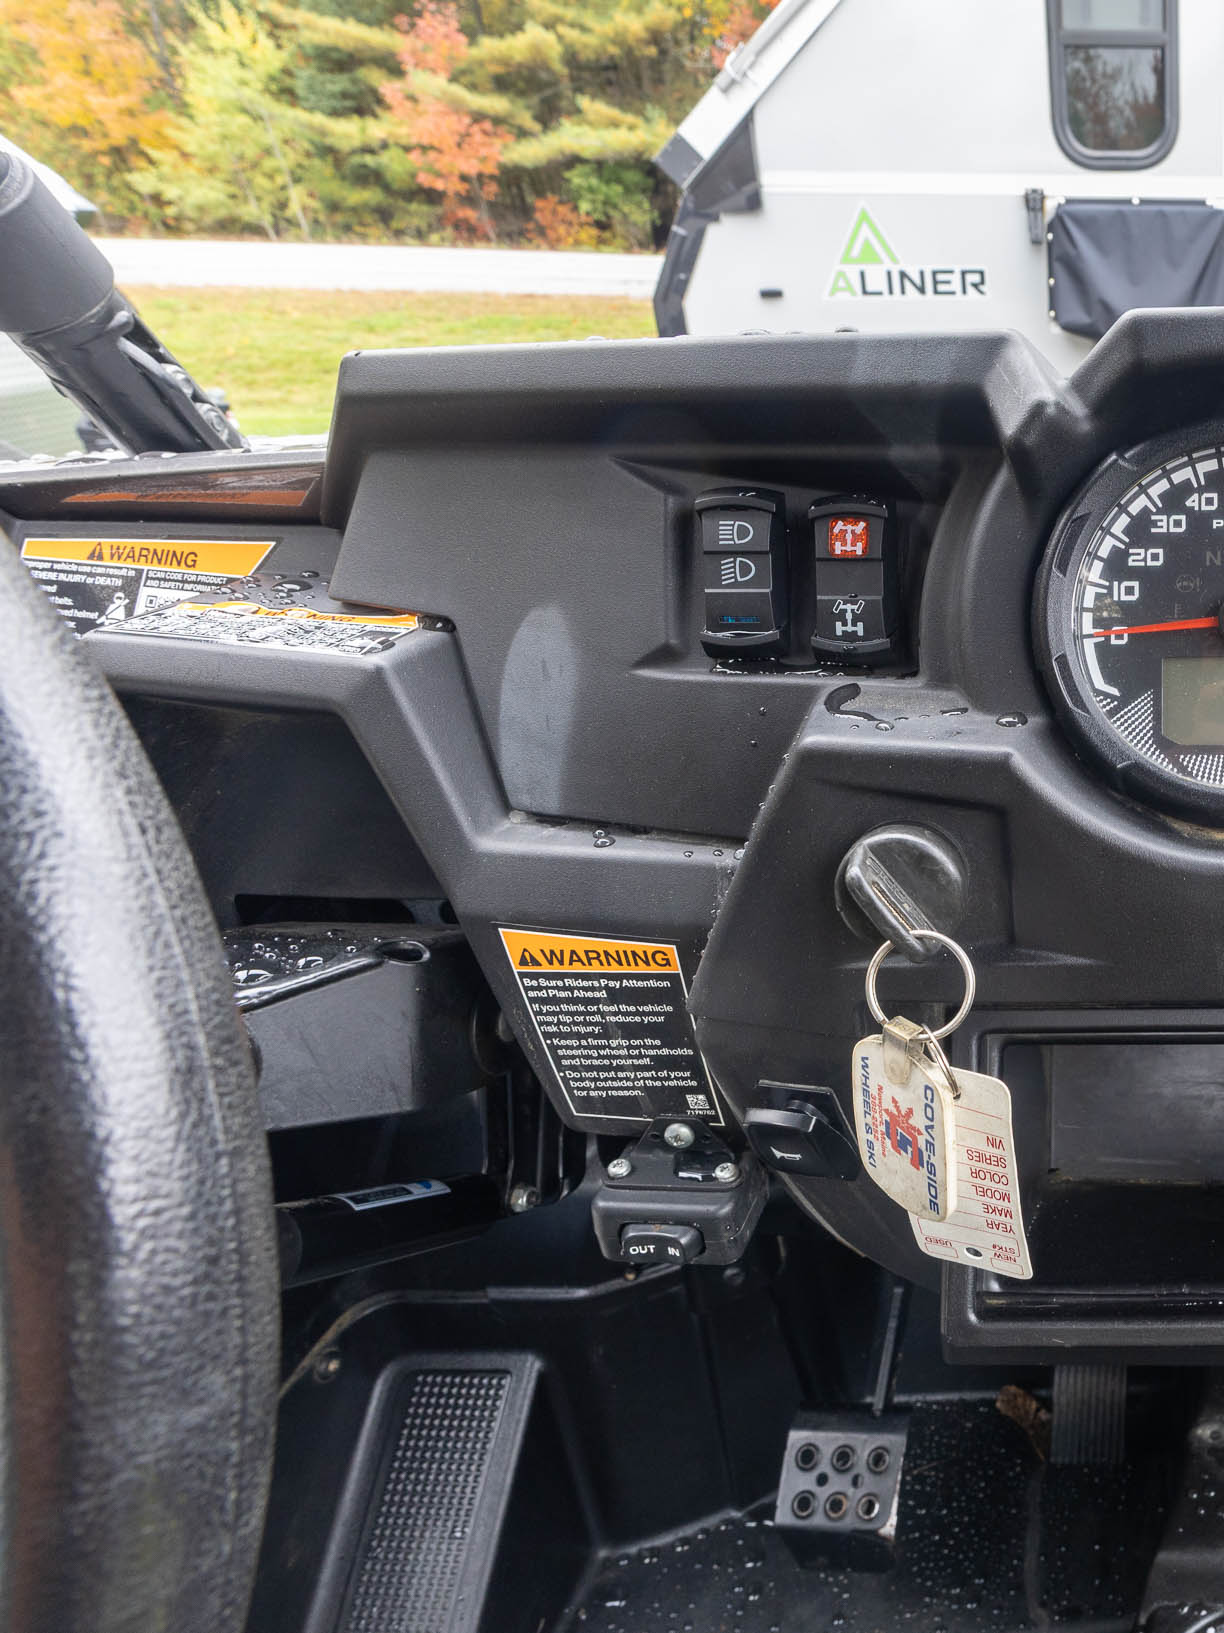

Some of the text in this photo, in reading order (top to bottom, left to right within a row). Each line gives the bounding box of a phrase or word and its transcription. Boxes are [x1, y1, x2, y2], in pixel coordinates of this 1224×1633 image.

[829, 270, 987, 296] ALINER
[1185, 492, 1218, 511] 40
[1150, 515, 1186, 533] 30
[109, 545, 199, 568] WARNING
[1128, 549, 1164, 566] 20
[1205, 550, 1222, 566] N
[95, 577, 122, 587] DEATH
[147, 570, 228, 586] SCAN CODE FOR PRODUCT
[160, 580, 184, 591] SAFETY
[1112, 581, 1140, 601] 10
[1111, 626, 1129, 645] 0
[540, 949, 672, 967] WARNING
[523, 978, 671, 989] Be Sure Riders Pay Attention
[527, 989, 607, 998] and Plan Ahead
[532, 1003, 541, 1012] If
[541, 1005, 559, 1014] you
[559, 1003, 586, 1012] think
[599, 1003, 617, 1012] feel
[618, 1004, 636, 1012] the
[637, 1004, 673, 1012] vehicle
[536, 1014, 665, 1024] may tip or roll, reduce your
[541, 1024, 603, 1034] risk to injury:
[553, 1038, 579, 1047] Keep
[588, 1038, 608, 1046] firm
[609, 1038, 629, 1048] grip
[643, 1038, 661, 1046] the
[557, 1048, 598, 1057] steering
[598, 1048, 628, 1056] wheel
[641, 1048, 694, 1056] handholds
[610, 1058, 654, 1067] yourself.
[599, 1071, 616, 1080] put
[617, 1071, 635, 1080] any
[636, 1071, 657, 1080] part
[668, 1071, 691, 1080] your
[570, 1080, 595, 1089] body
[573, 1089, 587, 1097] for
[589, 1090, 607, 1098] any
[861, 1056, 877, 1169] WHEEL & SKI
[923, 1084, 940, 1216] COVE-SIDE
[986, 1135, 1006, 1152] VIN
[966, 1148, 1007, 1169] SERIES
[969, 1166, 1009, 1186] COLOR
[971, 1185, 1011, 1203] MODEL
[981, 1202, 1014, 1220] MAKE
[985, 1219, 1016, 1235] YEAR
[925, 1236, 953, 1248] USED
[992, 1243, 1016, 1255] STK#
[629, 1245, 680, 1257] OUT IN
[993, 1252, 1017, 1263] NEW
